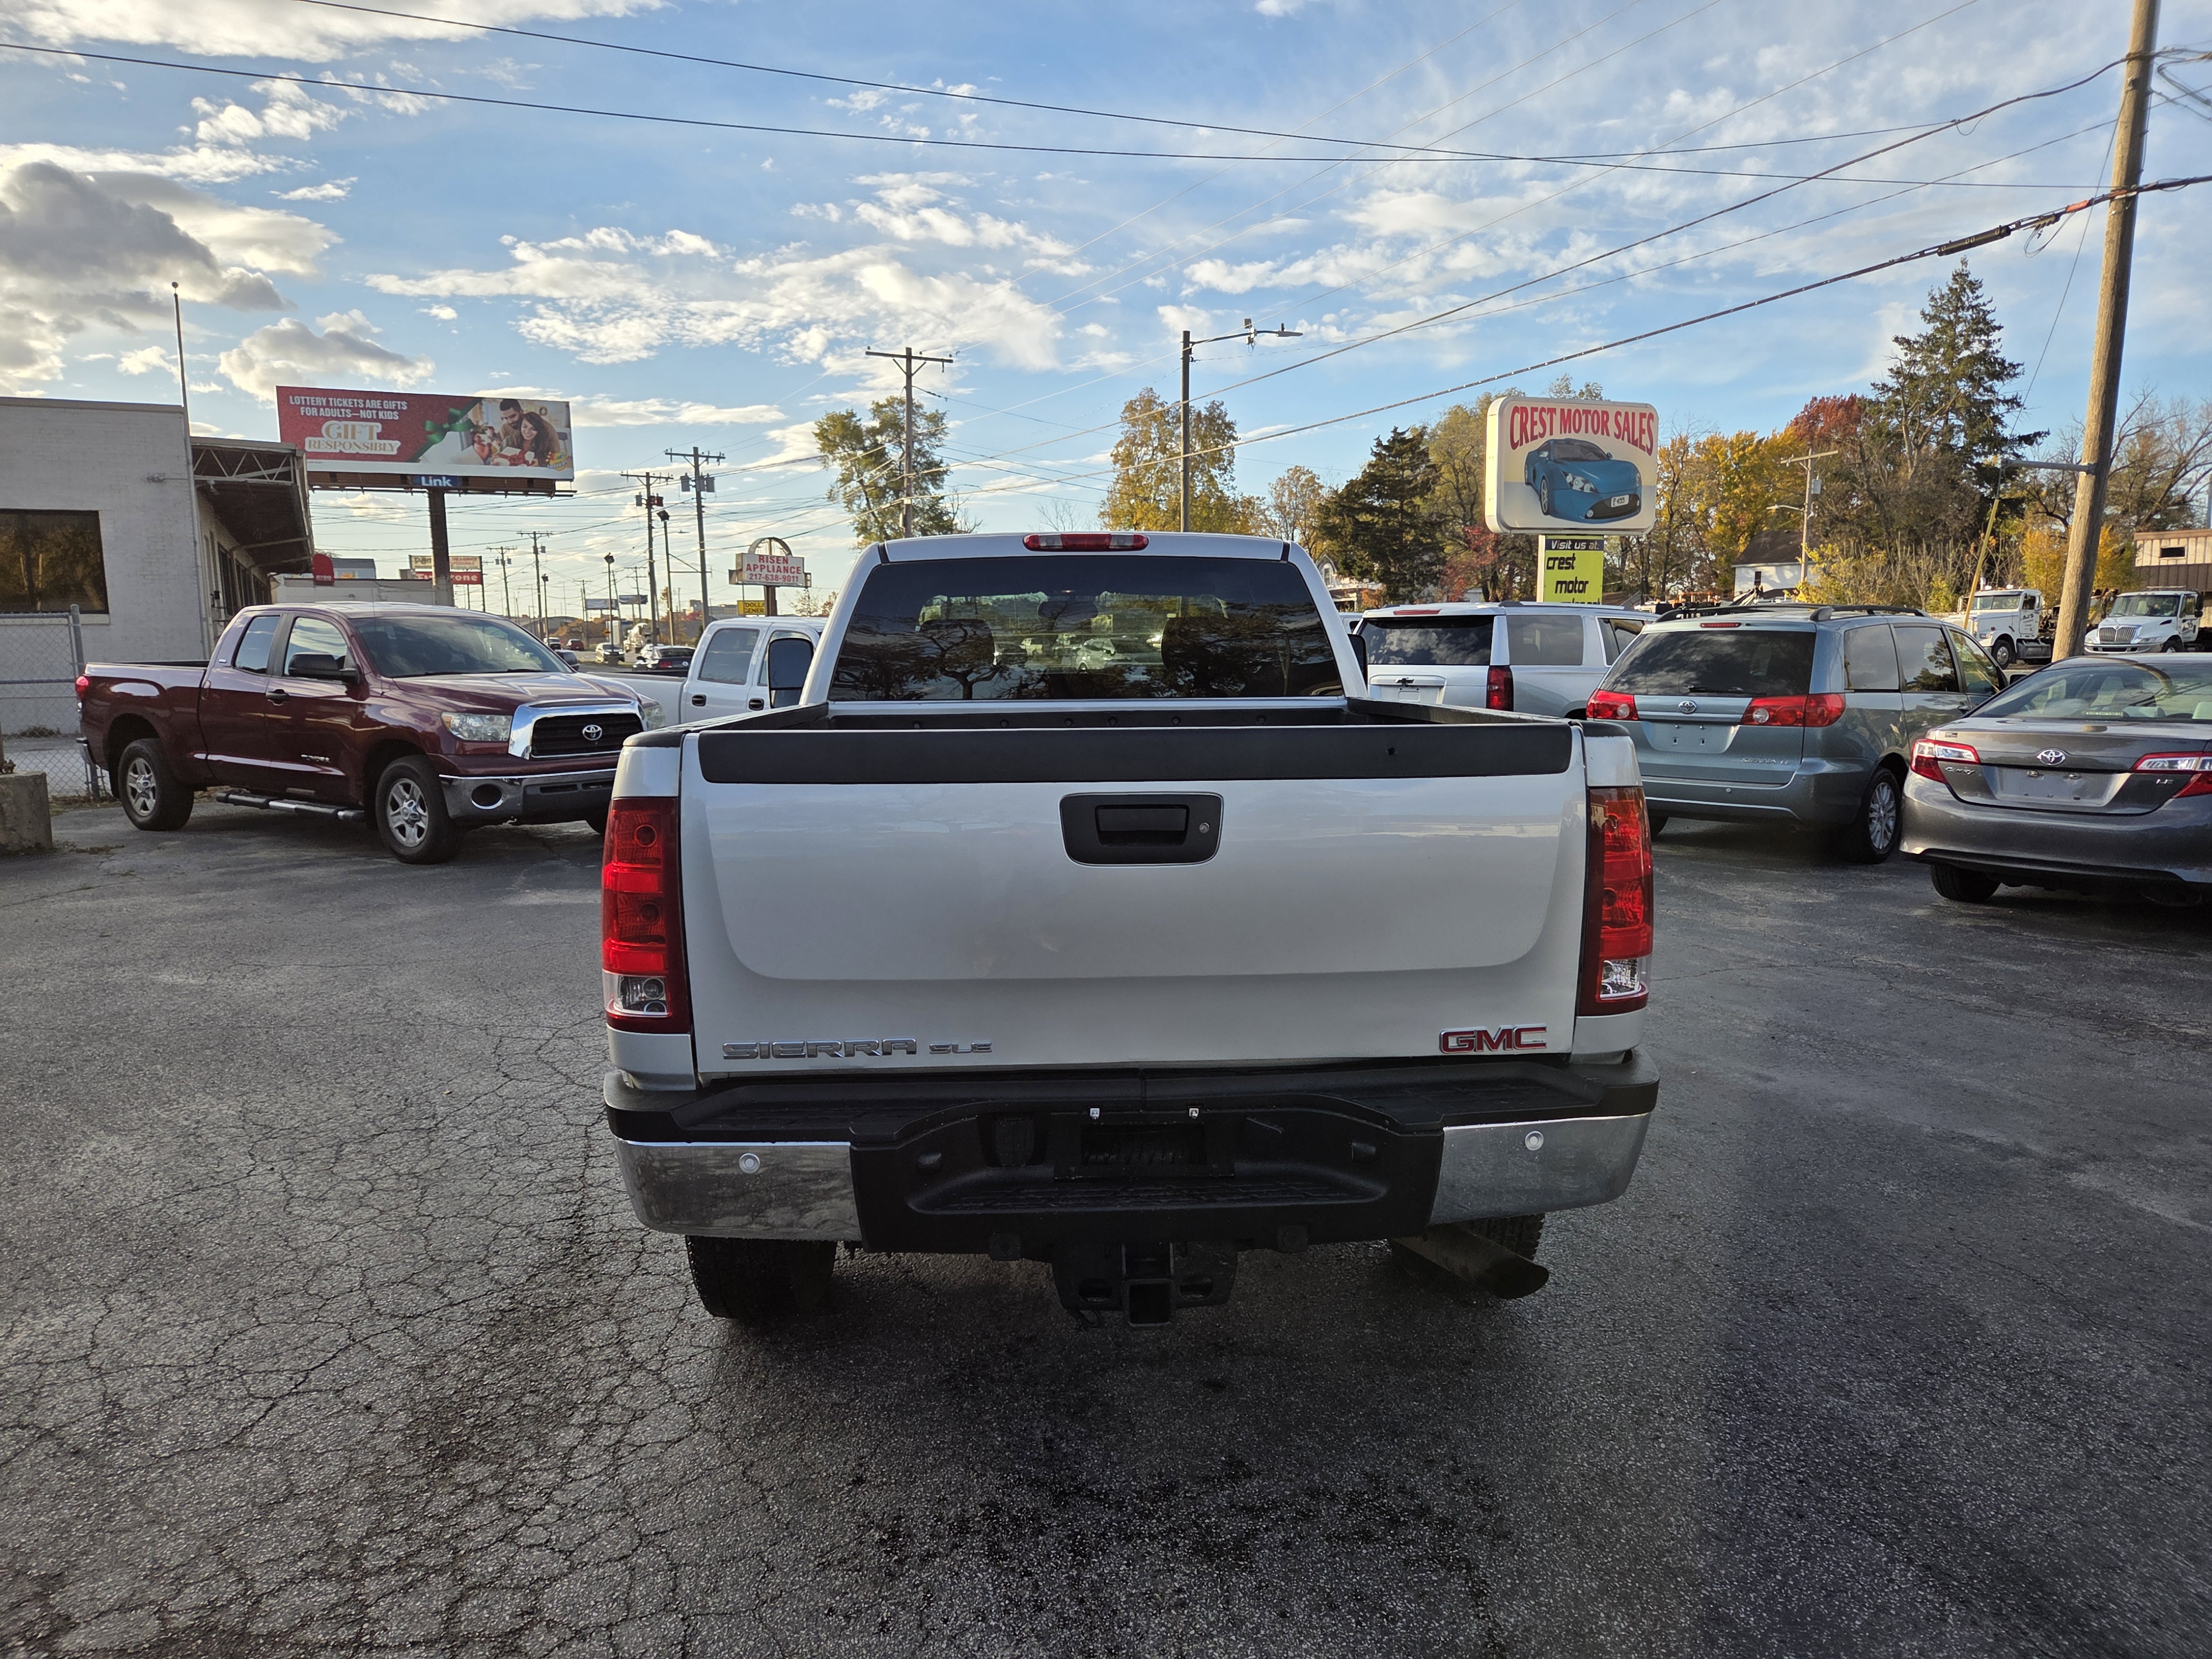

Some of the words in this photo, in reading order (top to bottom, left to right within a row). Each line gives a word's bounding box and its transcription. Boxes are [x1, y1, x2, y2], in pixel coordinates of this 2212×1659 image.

[289, 395, 327, 406] LOTTERY
[328, 398, 364, 408] TICKETS
[366, 399, 382, 409] ARE
[383, 400, 408, 410] GIFTS
[300, 406, 318, 416] FOR
[378, 410, 399, 420] KIDS
[325, 423, 379, 441] GIFT
[1510, 405, 1557, 451] CREST
[1559, 408, 1610, 437] MOTOR
[1614, 410, 1654, 457] SALES
[308, 440, 398, 452] RESPONSIBLY
[421, 476, 453, 487] Link
[1552, 540, 1572, 550] Visit
[1588, 541, 1599, 550] at:
[758, 555, 789, 565] RISEN
[1546, 553, 1575, 570] crest
[746, 564, 801, 575] APPLIANCE
[749, 573, 799, 582] 217-638-9011
[1554, 576, 1589, 594] motor
[1439, 1022, 1547, 1054] GMC
[723, 1037, 917, 1060] SIERRA
[929, 1041, 993, 1055] SLE
